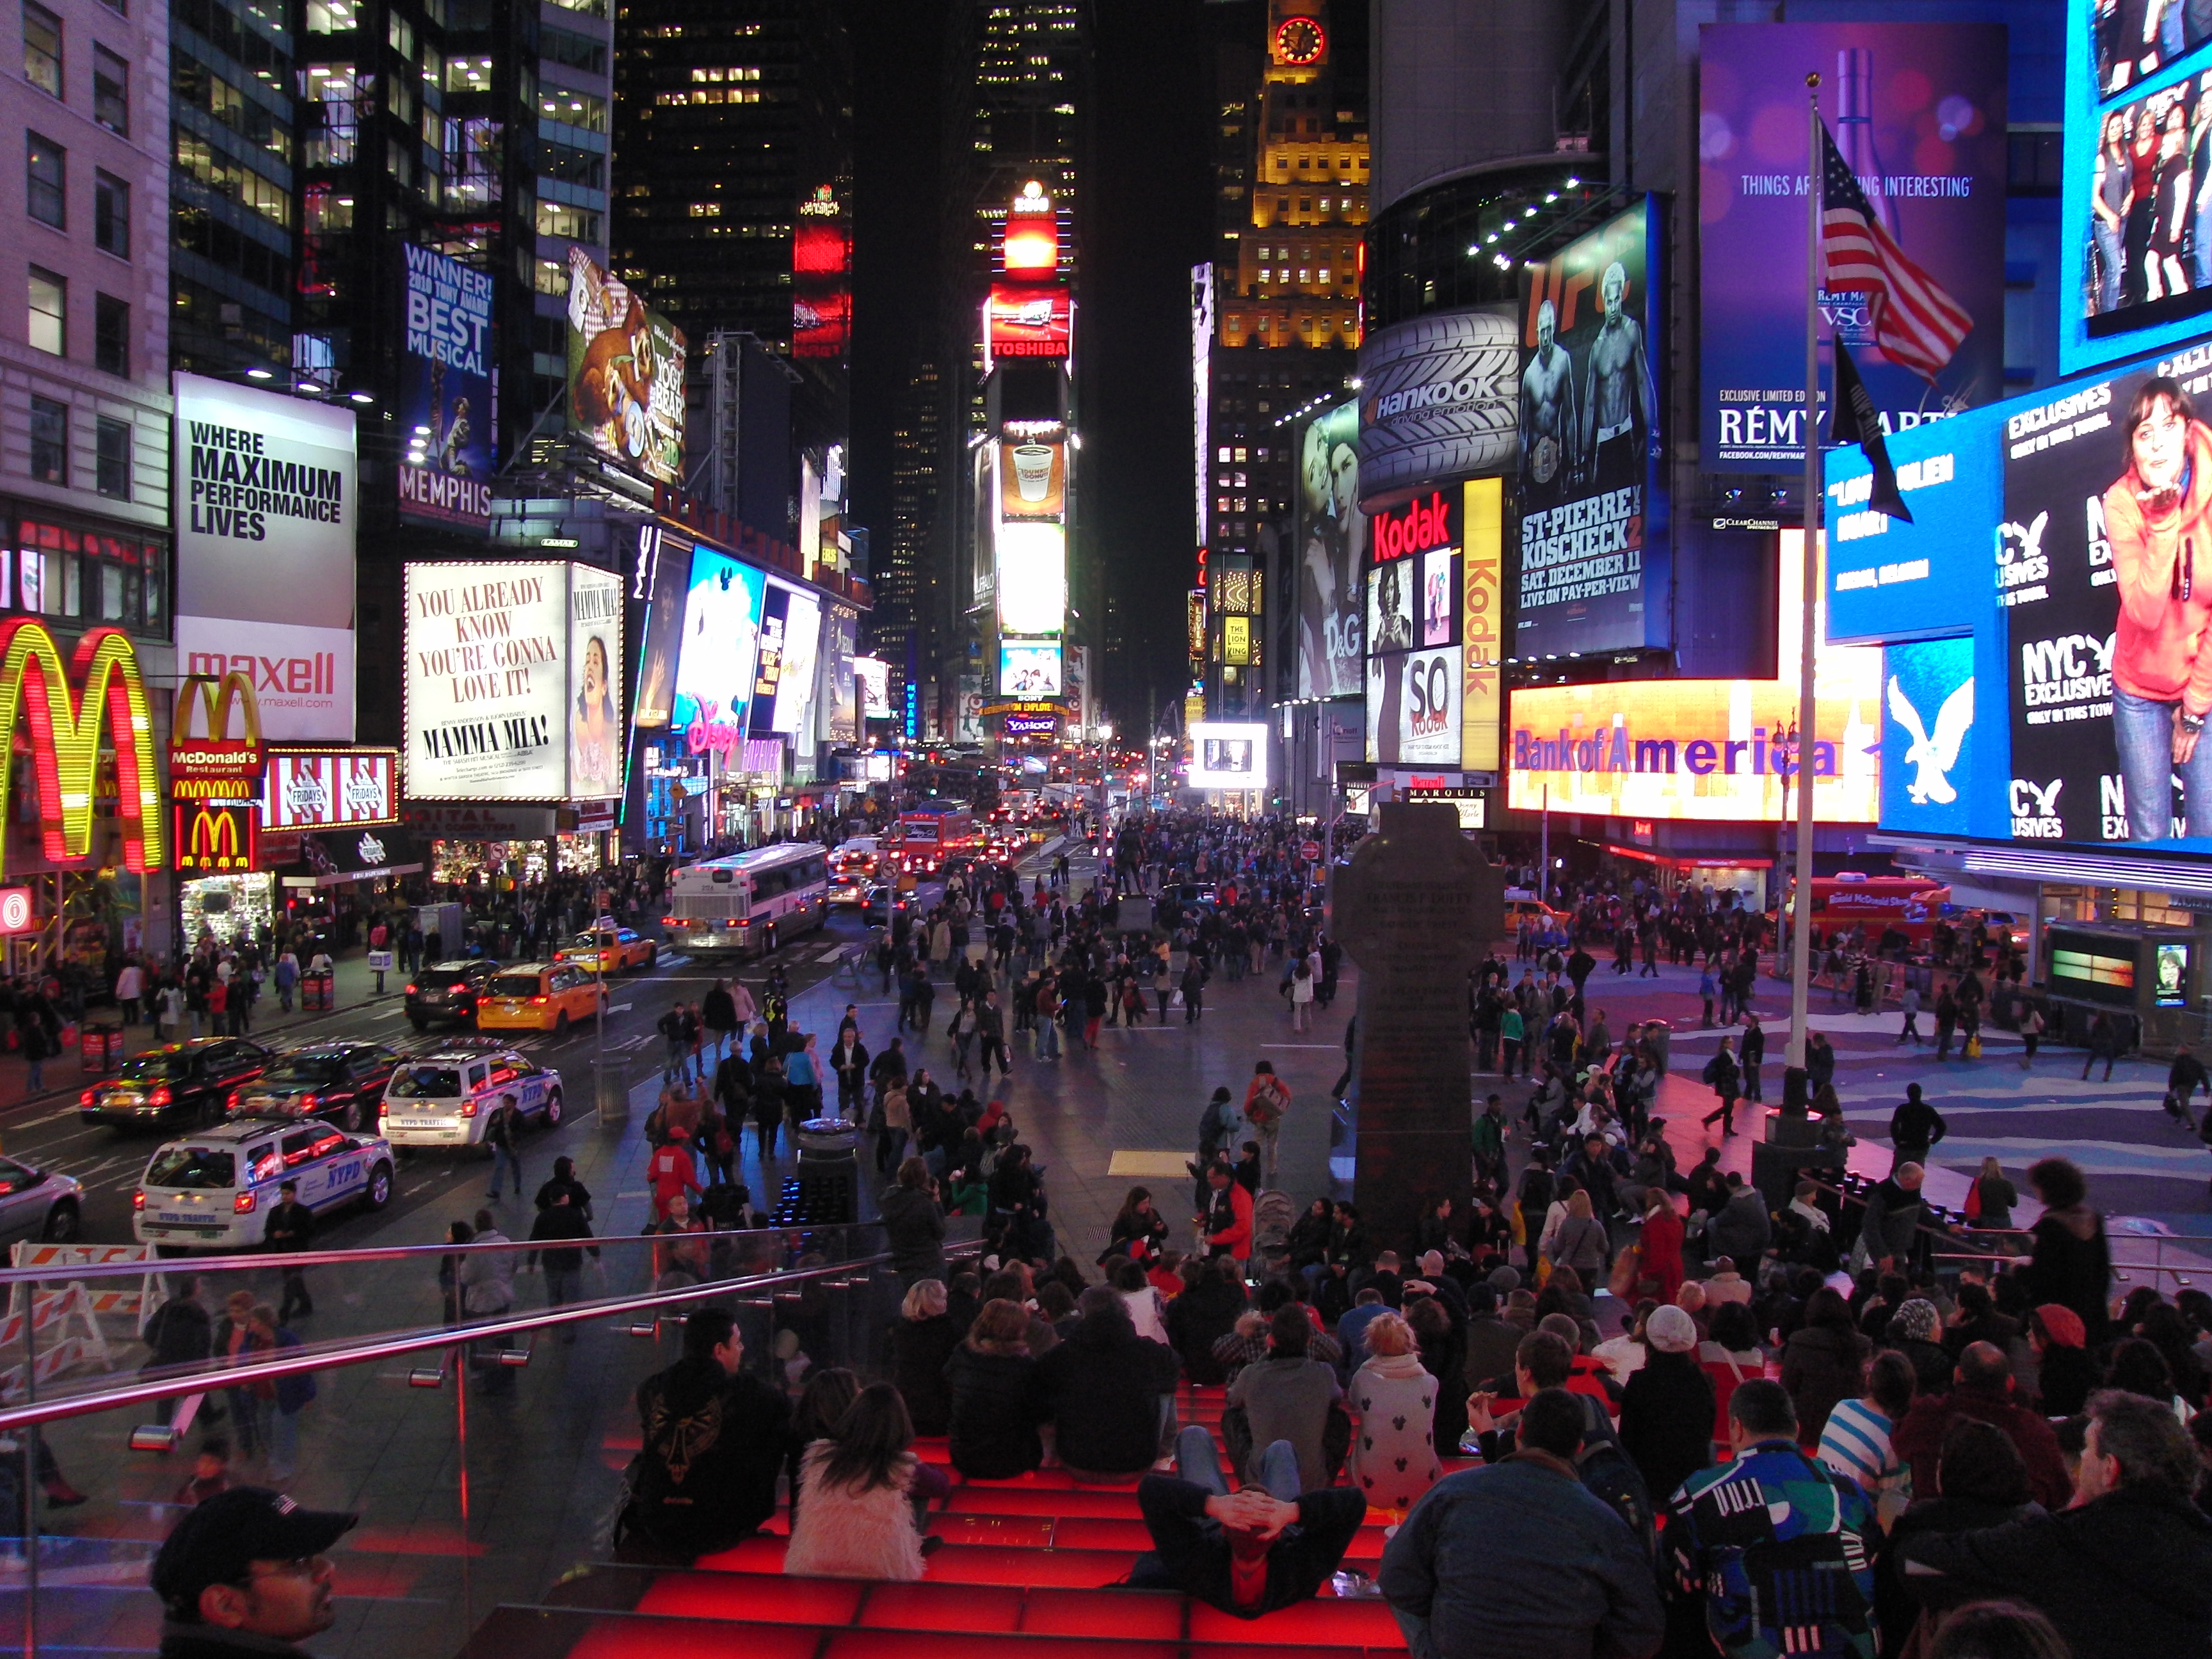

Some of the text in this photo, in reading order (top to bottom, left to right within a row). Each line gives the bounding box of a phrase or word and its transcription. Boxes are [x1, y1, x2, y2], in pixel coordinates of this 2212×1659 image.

[1742, 175, 1820, 195] THINGS AR
[1885, 176, 1970, 197] INTERESTING
[405, 242, 492, 301] WINNER!
[409, 270, 488, 317] 2010 TONY AWARD
[408, 289, 488, 353] BEST
[408, 330, 487, 377] MUSICAL
[992, 342, 1067, 355] TOSHIBA
[656, 353, 684, 396] YOGI
[655, 380, 684, 426] BEAR
[1391, 402, 1497, 426] driving emotion
[1720, 390, 1826, 402] EXCLUSIVE LIMITED EDON
[2008, 381, 2112, 440] EXCLUSIVES
[190, 421, 264, 454] WHERE
[190, 446, 341, 501] MAXIMUM
[399, 464, 491, 517] MEMPHIS
[191, 479, 341, 524] PERFORMANCE
[191, 502, 265, 541] LIVES
[1521, 486, 1631, 544] ST-PIERRE
[1374, 491, 1450, 563] Kodak
[1521, 516, 1642, 572] KOSCHECK 2
[1521, 550, 1641, 592] SAT. DECEMBER 11
[1521, 573, 1641, 609] LIVE ON PAY-PER-VIEW
[417, 577, 543, 618] YOU ALREADY
[456, 611, 511, 643] KNOW
[1228, 634, 1246, 645] LION
[1323, 607, 1360, 660] D&G
[1466, 559, 1497, 696] Kodak
[189, 652, 334, 694] maxell
[419, 636, 557, 677] YOU'RE GONNA
[1228, 648, 1246, 658] KING
[2021, 634, 2087, 684] NYC
[452, 667, 531, 703] LOVE IT!
[1411, 656, 1450, 716] SO
[2024, 673, 2113, 706] EXCLUSIVE
[1007, 721, 1054, 731] YAHOO!
[2089, 702, 2113, 718] TOW
[422, 714, 550, 760] MAMMA MIA!
[689, 693, 739, 770] Disney
[1515, 727, 1836, 776] Bank of America
[172, 751, 258, 764] McDonald's
[405, 809, 495, 822] IGITAL
[2010, 816, 2063, 838] USIVES
[521, 1083, 543, 1105] NYPD
[326, 1160, 360, 1189] NYPD
